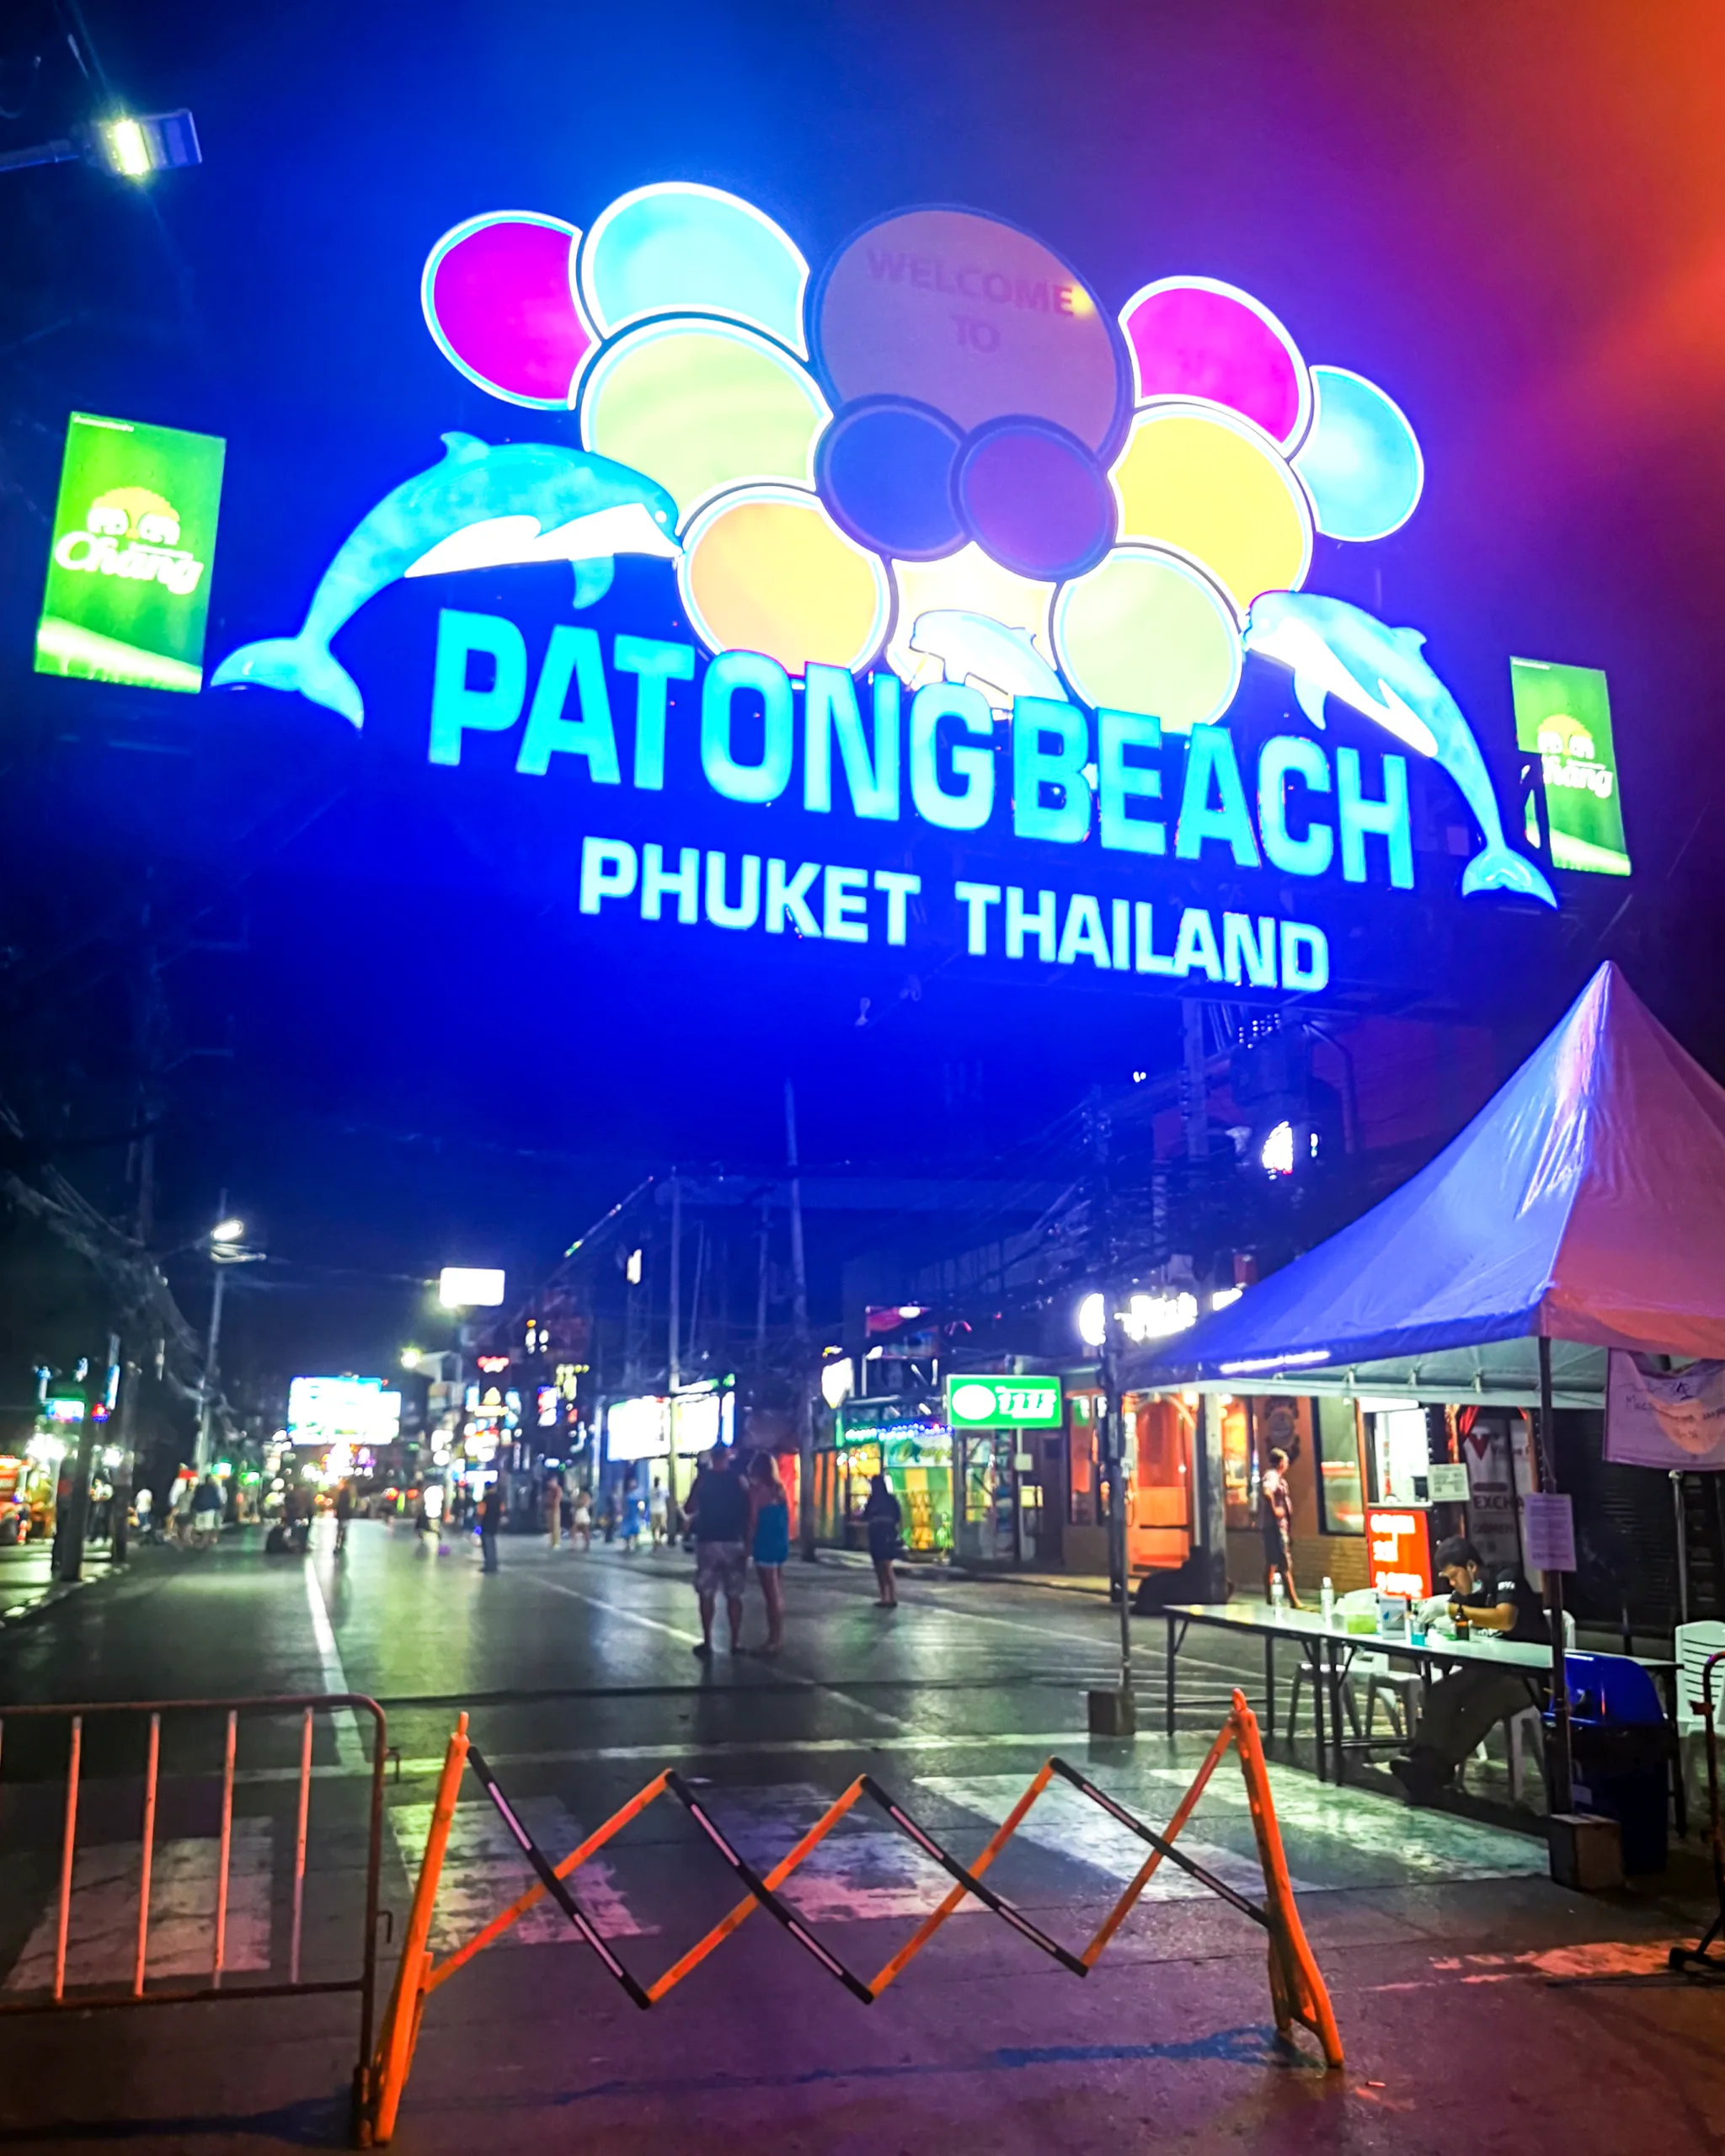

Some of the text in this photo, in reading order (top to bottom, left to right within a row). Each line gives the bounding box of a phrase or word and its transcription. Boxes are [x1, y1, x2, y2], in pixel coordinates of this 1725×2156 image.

[868, 247, 1074, 317] WELCOME
[949, 313, 1001, 354] TO
[55, 531, 204, 595] Chang
[429, 608, 1414, 889] PATONG BEACH
[1541, 754, 1614, 799] hang
[579, 836, 1329, 992] PHUKET THAILAND
